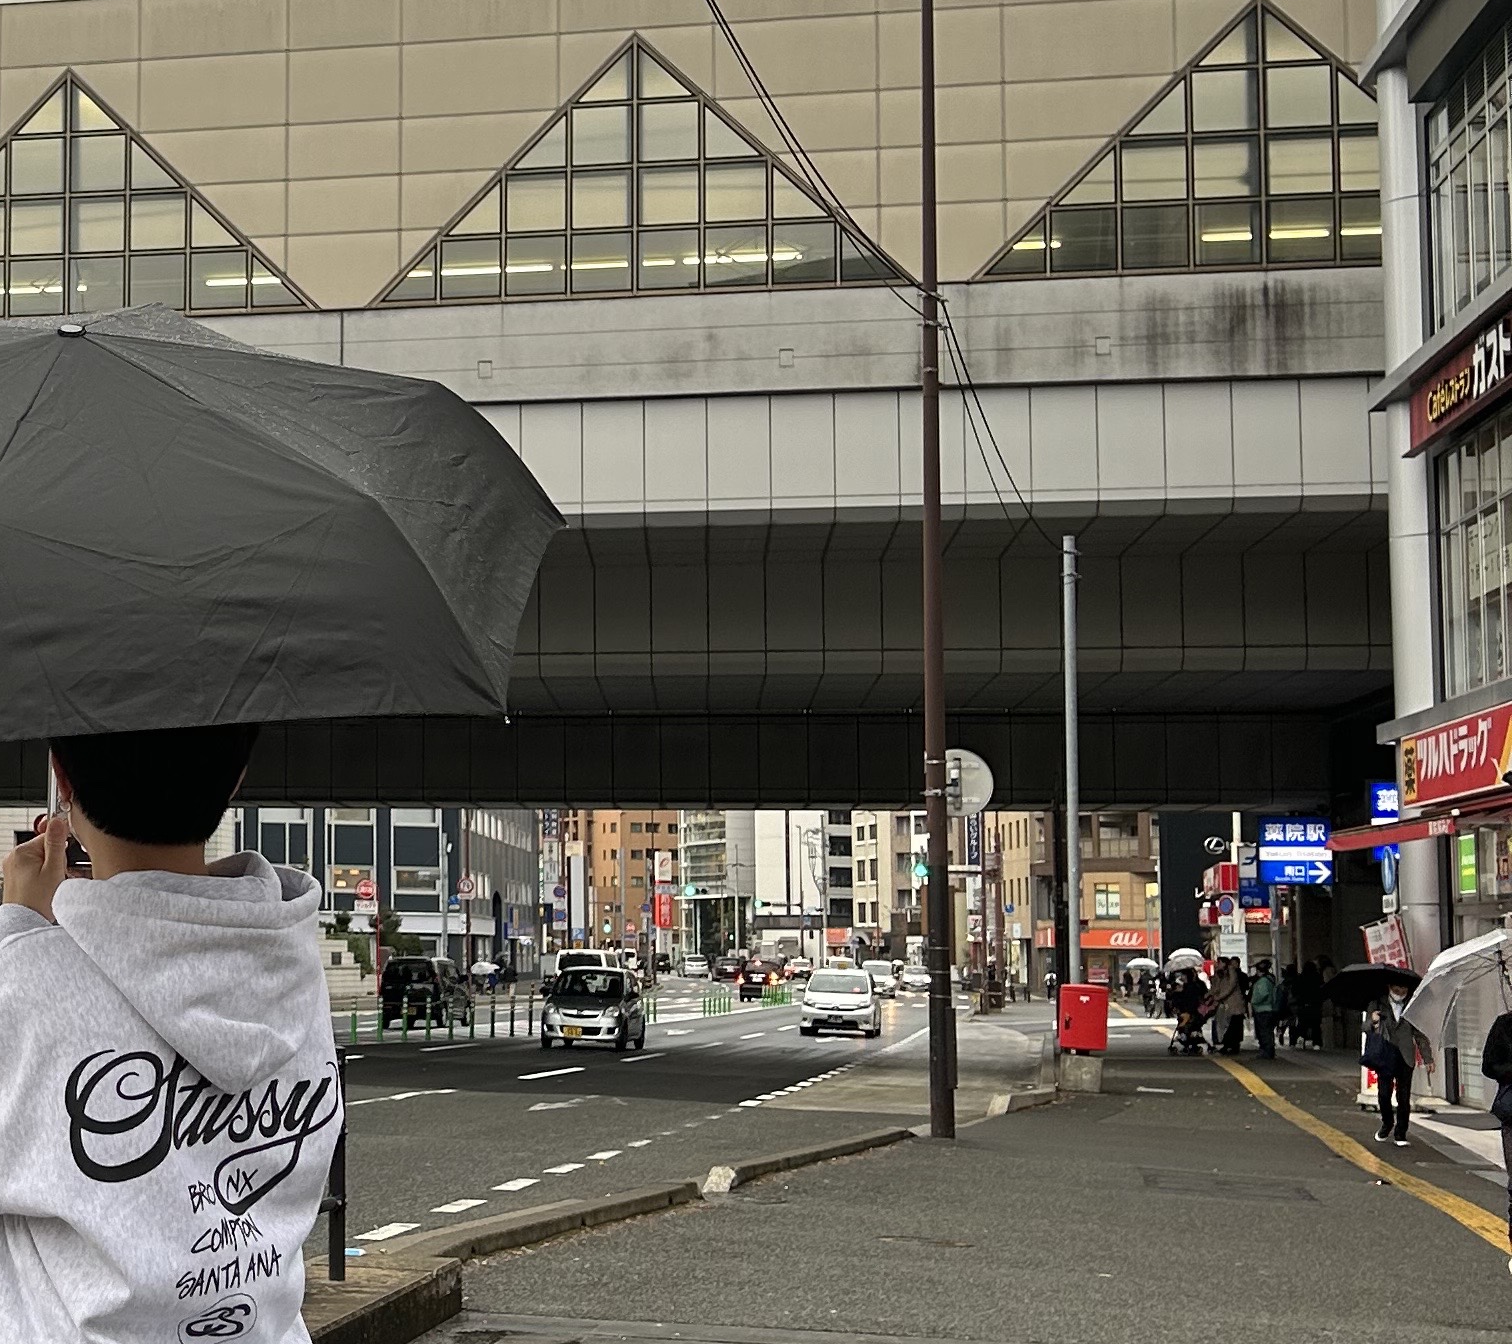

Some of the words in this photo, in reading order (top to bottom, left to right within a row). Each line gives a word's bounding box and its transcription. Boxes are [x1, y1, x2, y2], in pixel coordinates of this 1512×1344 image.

[1473, 323, 1511, 400] ガスト
[1416, 716, 1493, 782] ツルハドラッグ
[1264, 823, 1326, 842] 薬院駅
[1109, 931, 1144, 947] au
[191, 1213, 263, 1254] COMPTON
[176, 1256, 240, 1299] SANTA
[245, 1244, 282, 1283] ANA
